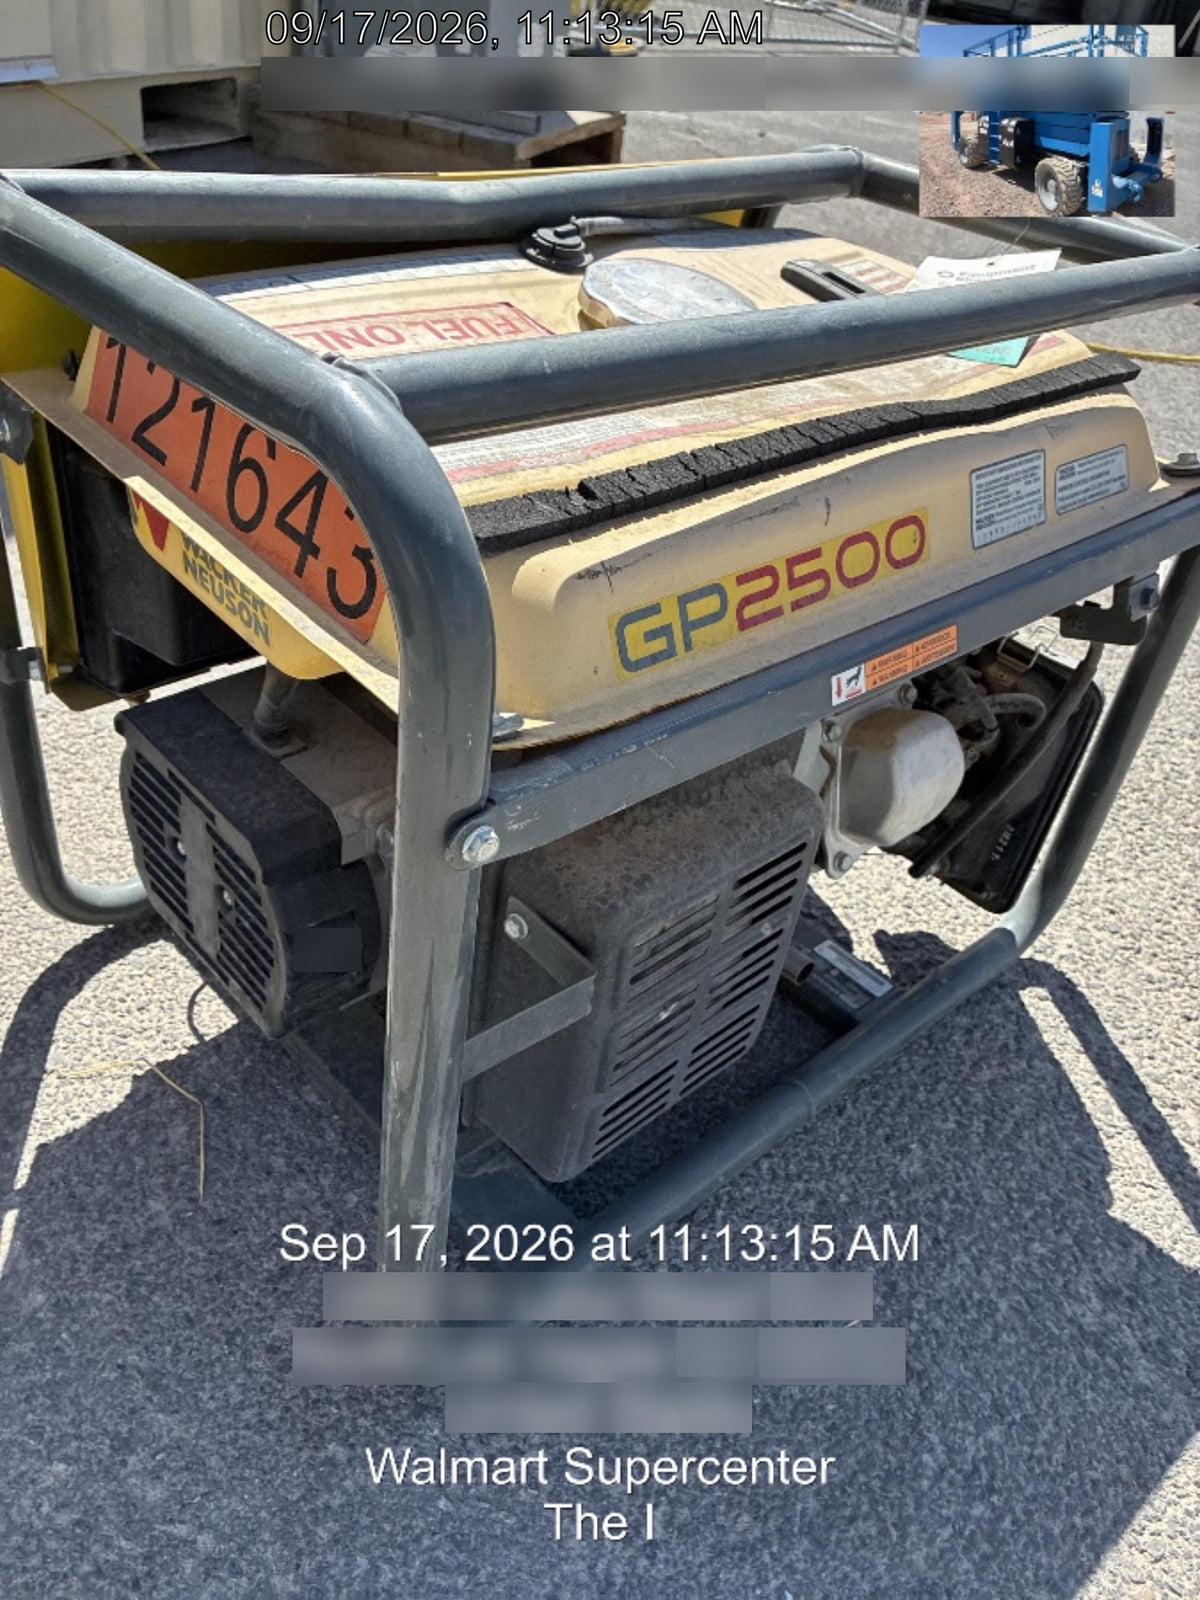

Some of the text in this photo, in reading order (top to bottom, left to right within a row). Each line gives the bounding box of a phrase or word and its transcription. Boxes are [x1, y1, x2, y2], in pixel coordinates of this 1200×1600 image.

[292, 314, 523, 351] FUEL ONL
[106, 336, 379, 620] 121643
[182, 549, 271, 648] NEUSON
[615, 514, 926, 674] GP2500
